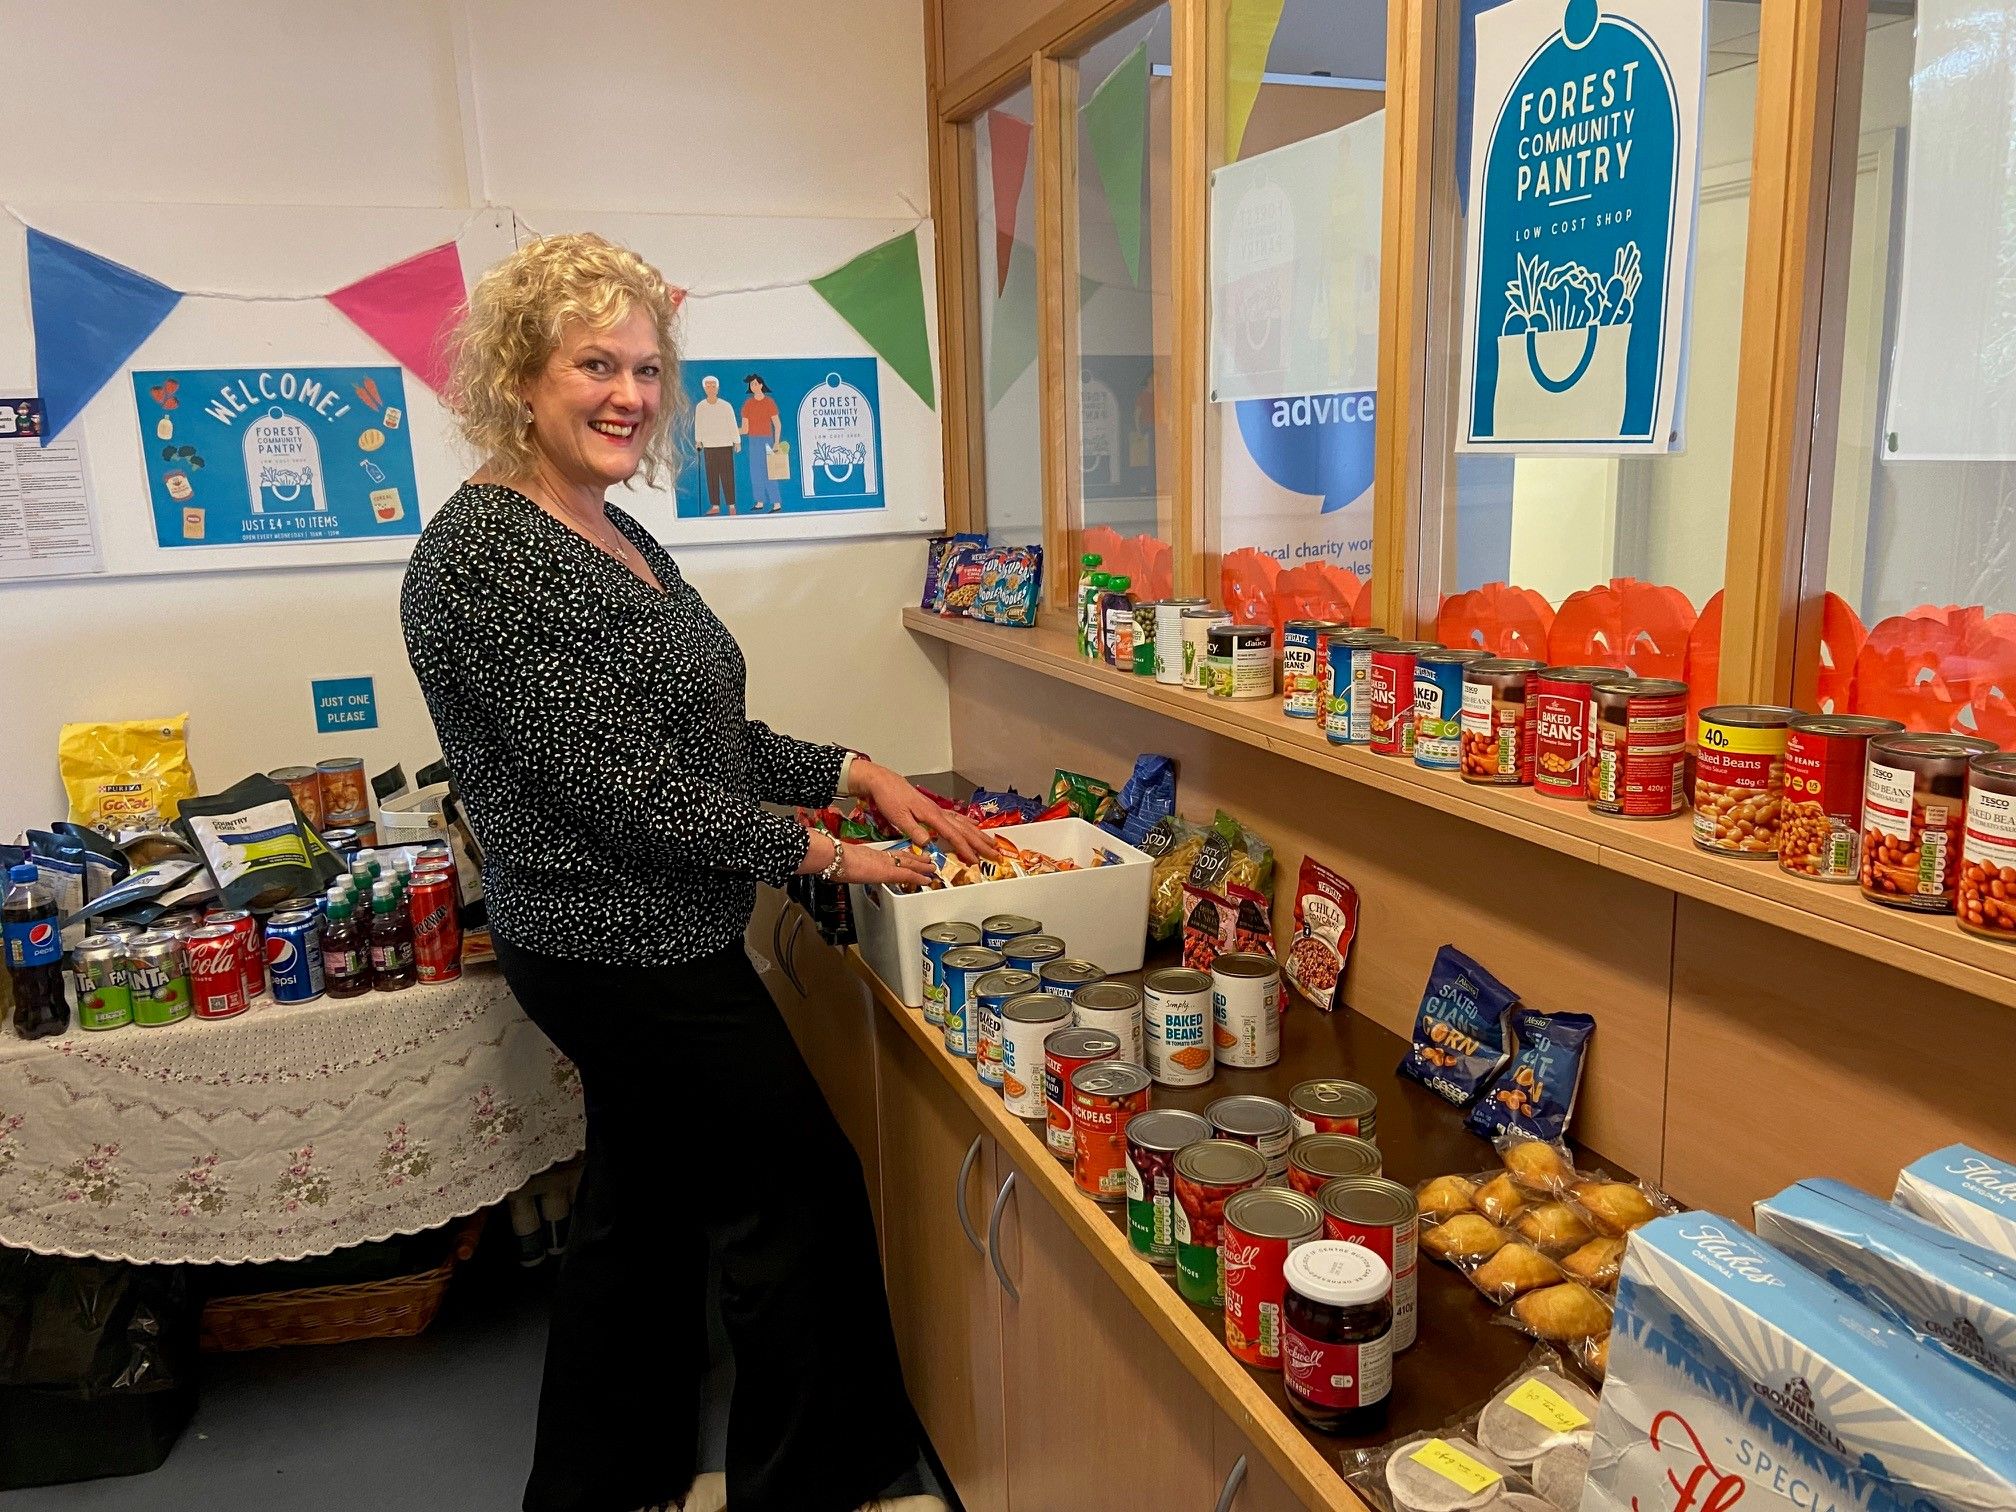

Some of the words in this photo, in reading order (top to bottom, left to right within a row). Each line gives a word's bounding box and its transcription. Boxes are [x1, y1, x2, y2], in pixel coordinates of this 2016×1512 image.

[1519, 60, 1639, 131] FOREST
[1517, 108, 1635, 160] COMMUNITY
[1517, 139, 1633, 201] PANTRY
[1515, 225, 1542, 242] LOW
[1550, 217, 1587, 235] COST
[1596, 208, 1633, 227] SHOP
[204, 372, 351, 426] WELCOME!
[812, 396, 858, 408] FOREST
[812, 408, 859, 416] COMMUNITY
[1271, 395, 1375, 428] advice
[813, 416, 859, 428] PANTRY
[256, 426, 302, 437] FOREST
[258, 443, 303, 454] PANTRY
[241, 520, 265, 532] JUST
[269, 518, 283, 530] £4
[294, 517, 306, 529] 10
[308, 516, 339, 528] ITEMS
[1295, 538, 1344, 558] charity
[1284, 650, 1312, 663] AKED
[320, 696, 344, 708] JUST
[348, 694, 370, 705] ONE
[1371, 688, 1396, 704] EANS
[1414, 687, 1439, 703] AKED
[1414, 699, 1432, 711] EANS
[327, 710, 366, 723] PLEASE
[1542, 711, 1571, 725] BAKED
[1537, 720, 1583, 741] BEANS
[1705, 728, 1729, 748] 40p
[1722, 756, 1761, 769] Beans
[1794, 755, 1820, 768] BEANS
[1873, 767, 1893, 779] TESCO
[1881, 783, 1911, 798] BEANS
[1981, 795, 2010, 809] TESCO
[1994, 811, 2016, 825] BEA
[1308, 901, 1340, 923] CHILLI
[34, 946, 54, 957] pepsi
[188, 939, 235, 975] Cola
[1045, 986, 1074, 998] NEWGAT
[1439, 984, 1479, 1020] SALTED
[1165, 1013, 1203, 1027] BAKED
[1166, 1026, 1203, 1041] BEANS
[1679, 1225, 1785, 1287] Flakes
[1753, 1382, 1847, 1455] CROWNFIELD
